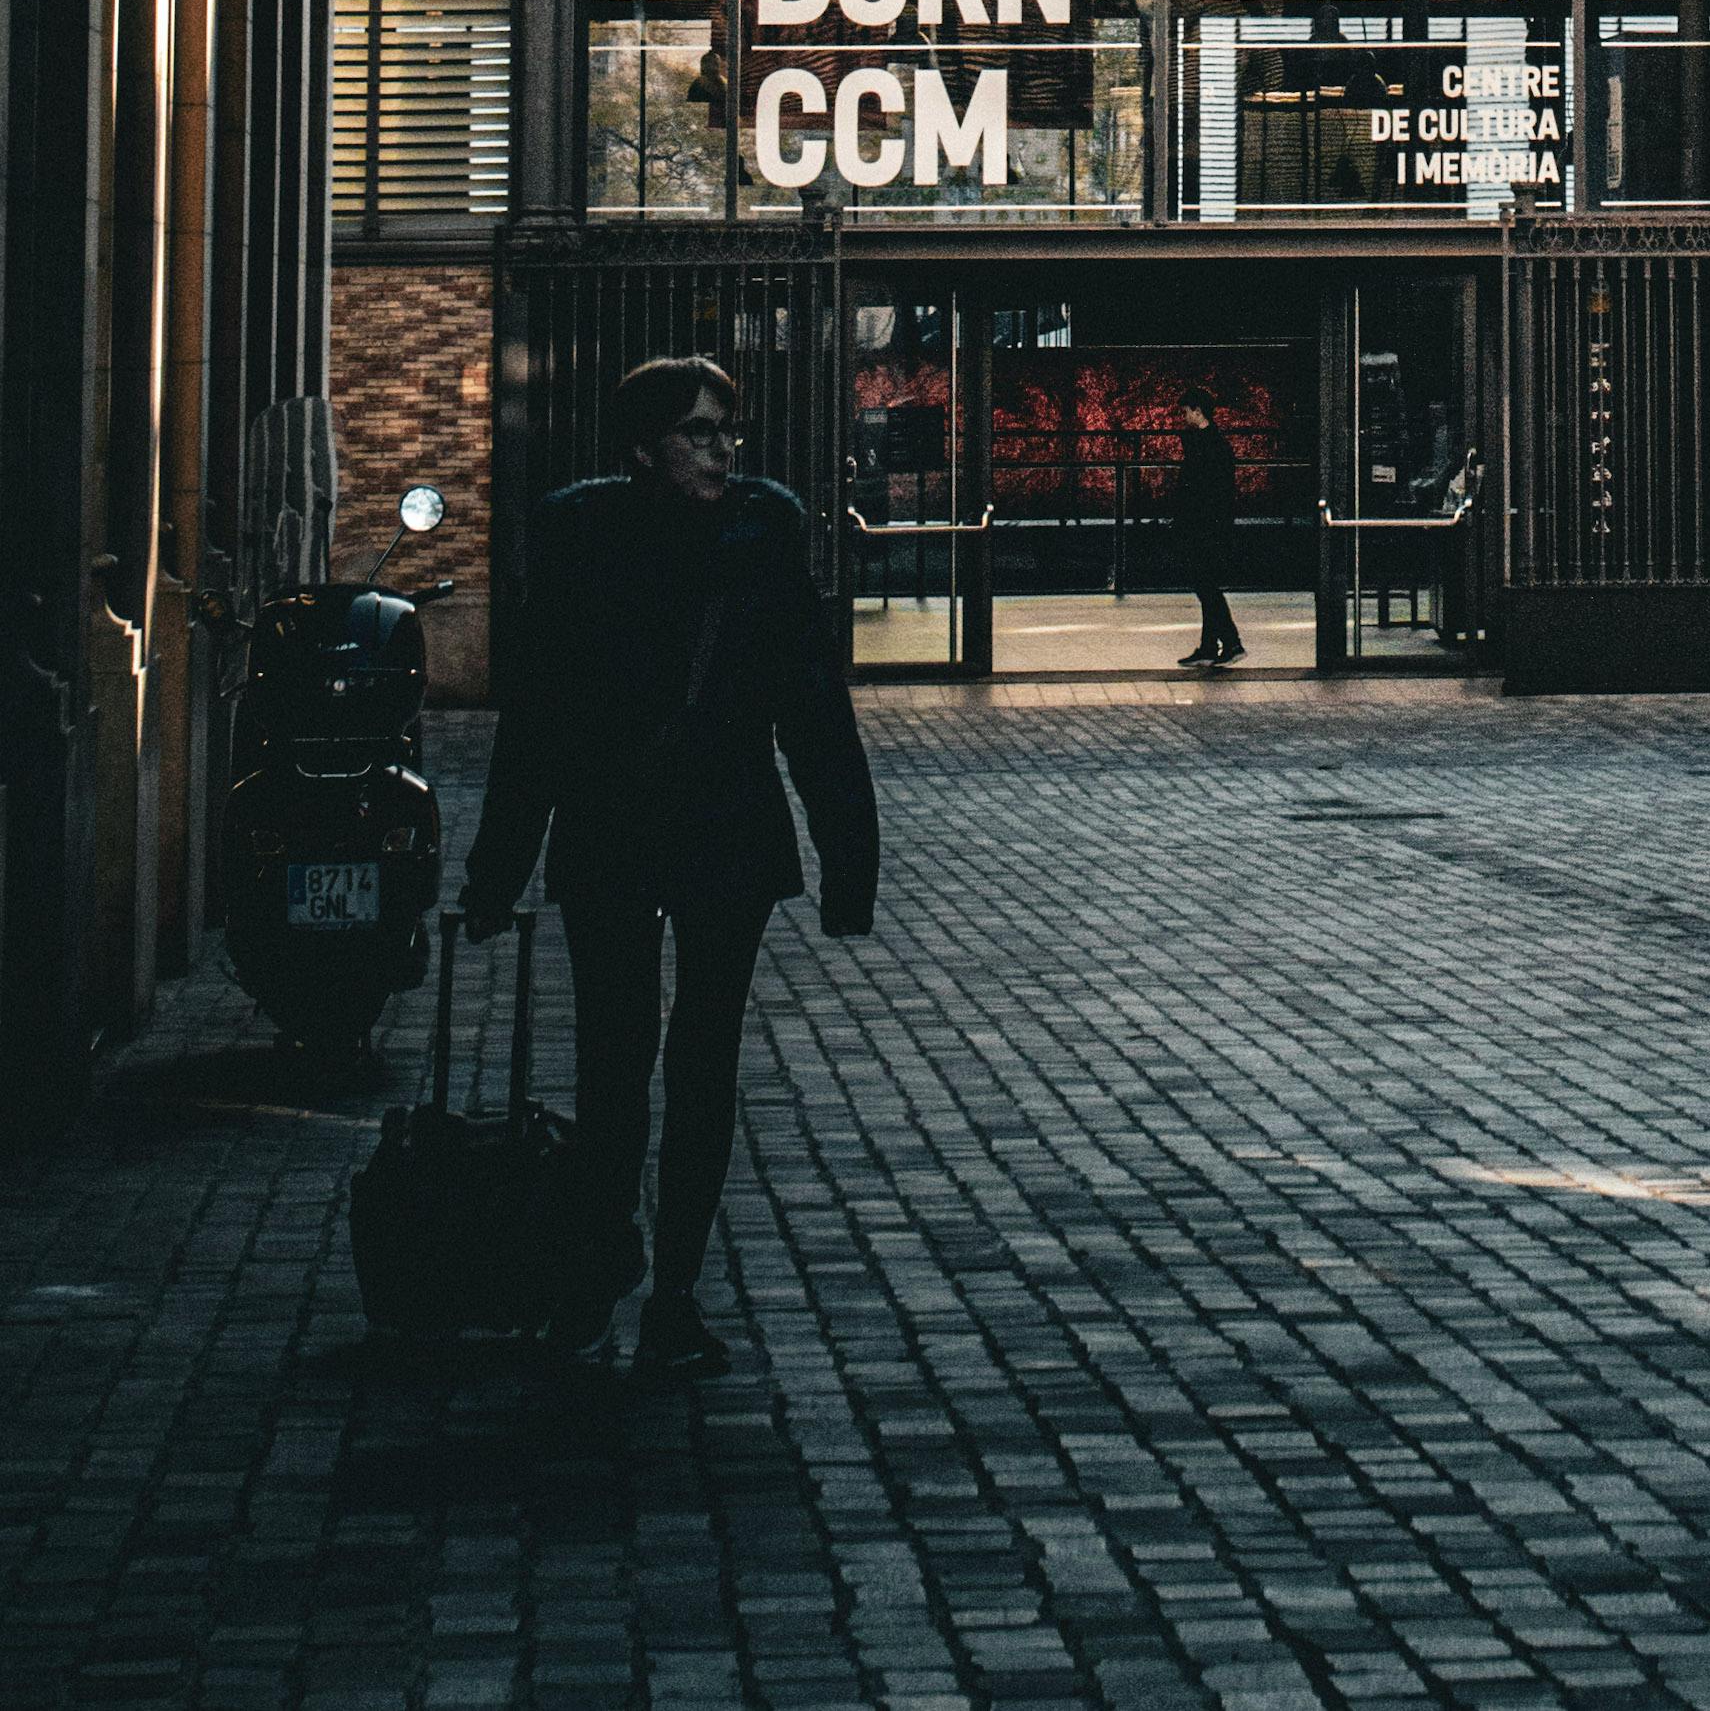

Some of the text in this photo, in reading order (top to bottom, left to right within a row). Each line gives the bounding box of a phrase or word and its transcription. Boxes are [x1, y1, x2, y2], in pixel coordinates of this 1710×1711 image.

[1442, 64, 1560, 98] CENTRE
[755, 67, 1008, 187] CCM
[1371, 107, 1560, 141] DE CULTURA
[1397, 151, 1407, 185] I
[307, 866, 372, 893] 8714
[310, 894, 357, 919] GNL
